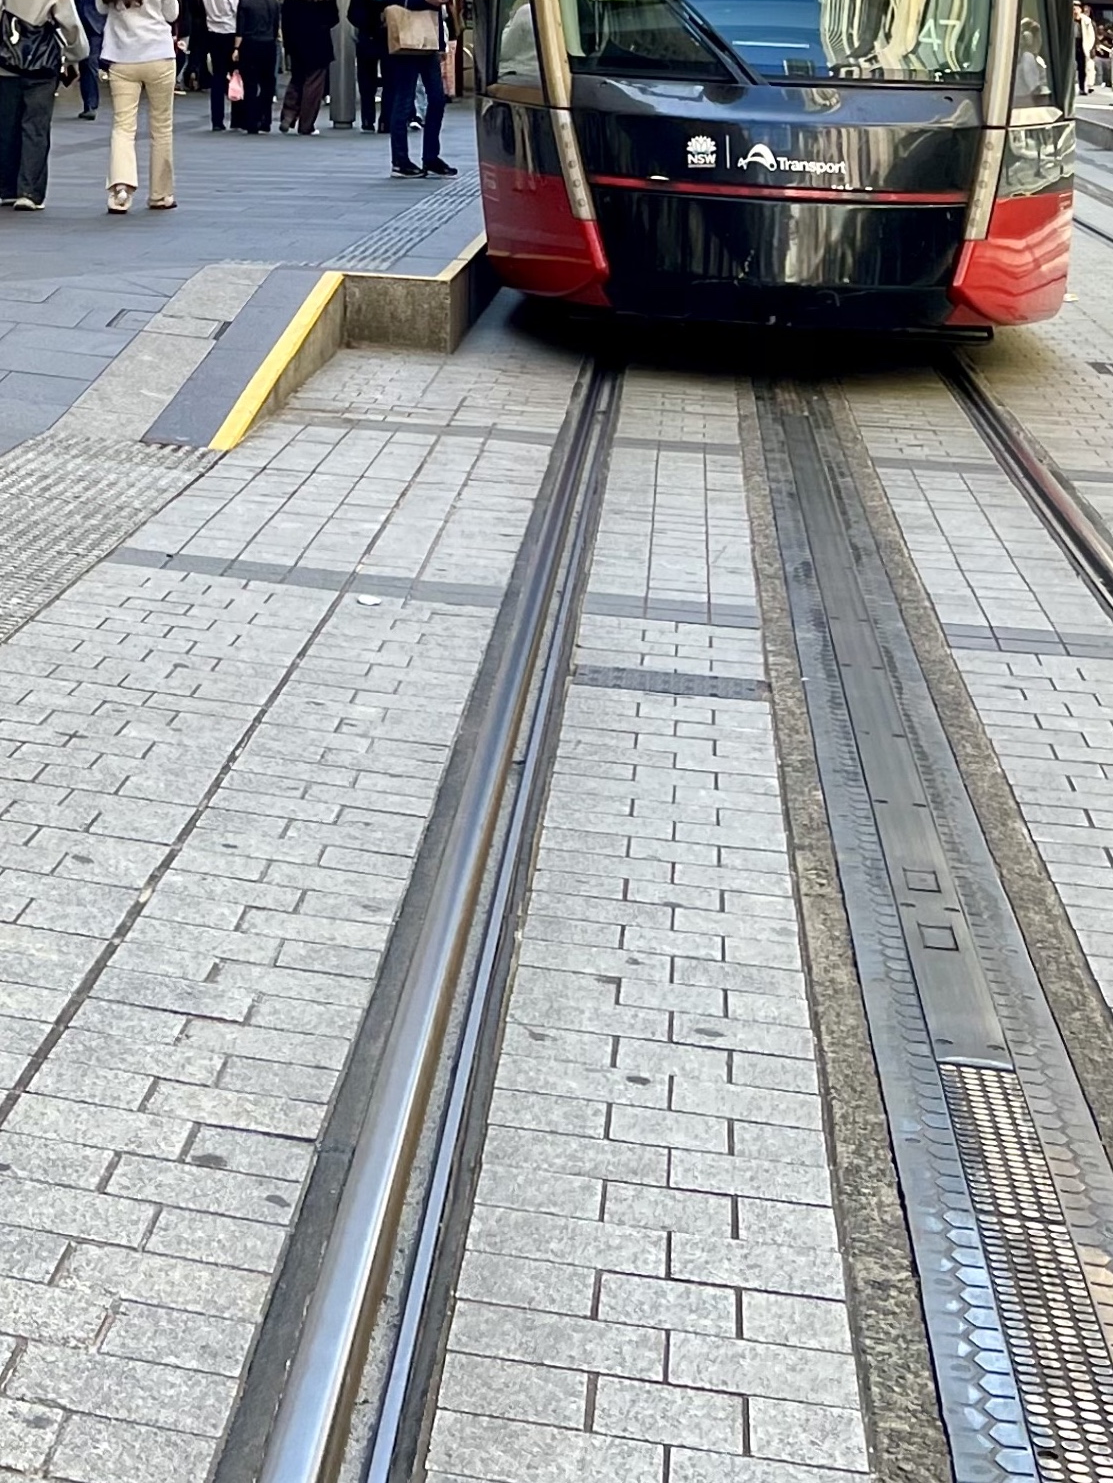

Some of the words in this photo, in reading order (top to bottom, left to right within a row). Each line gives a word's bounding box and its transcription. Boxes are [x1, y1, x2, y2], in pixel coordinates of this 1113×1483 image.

[918, 18, 961, 52] 47
[687, 154, 717, 164] NSW
[777, 156, 846, 175] Transport
